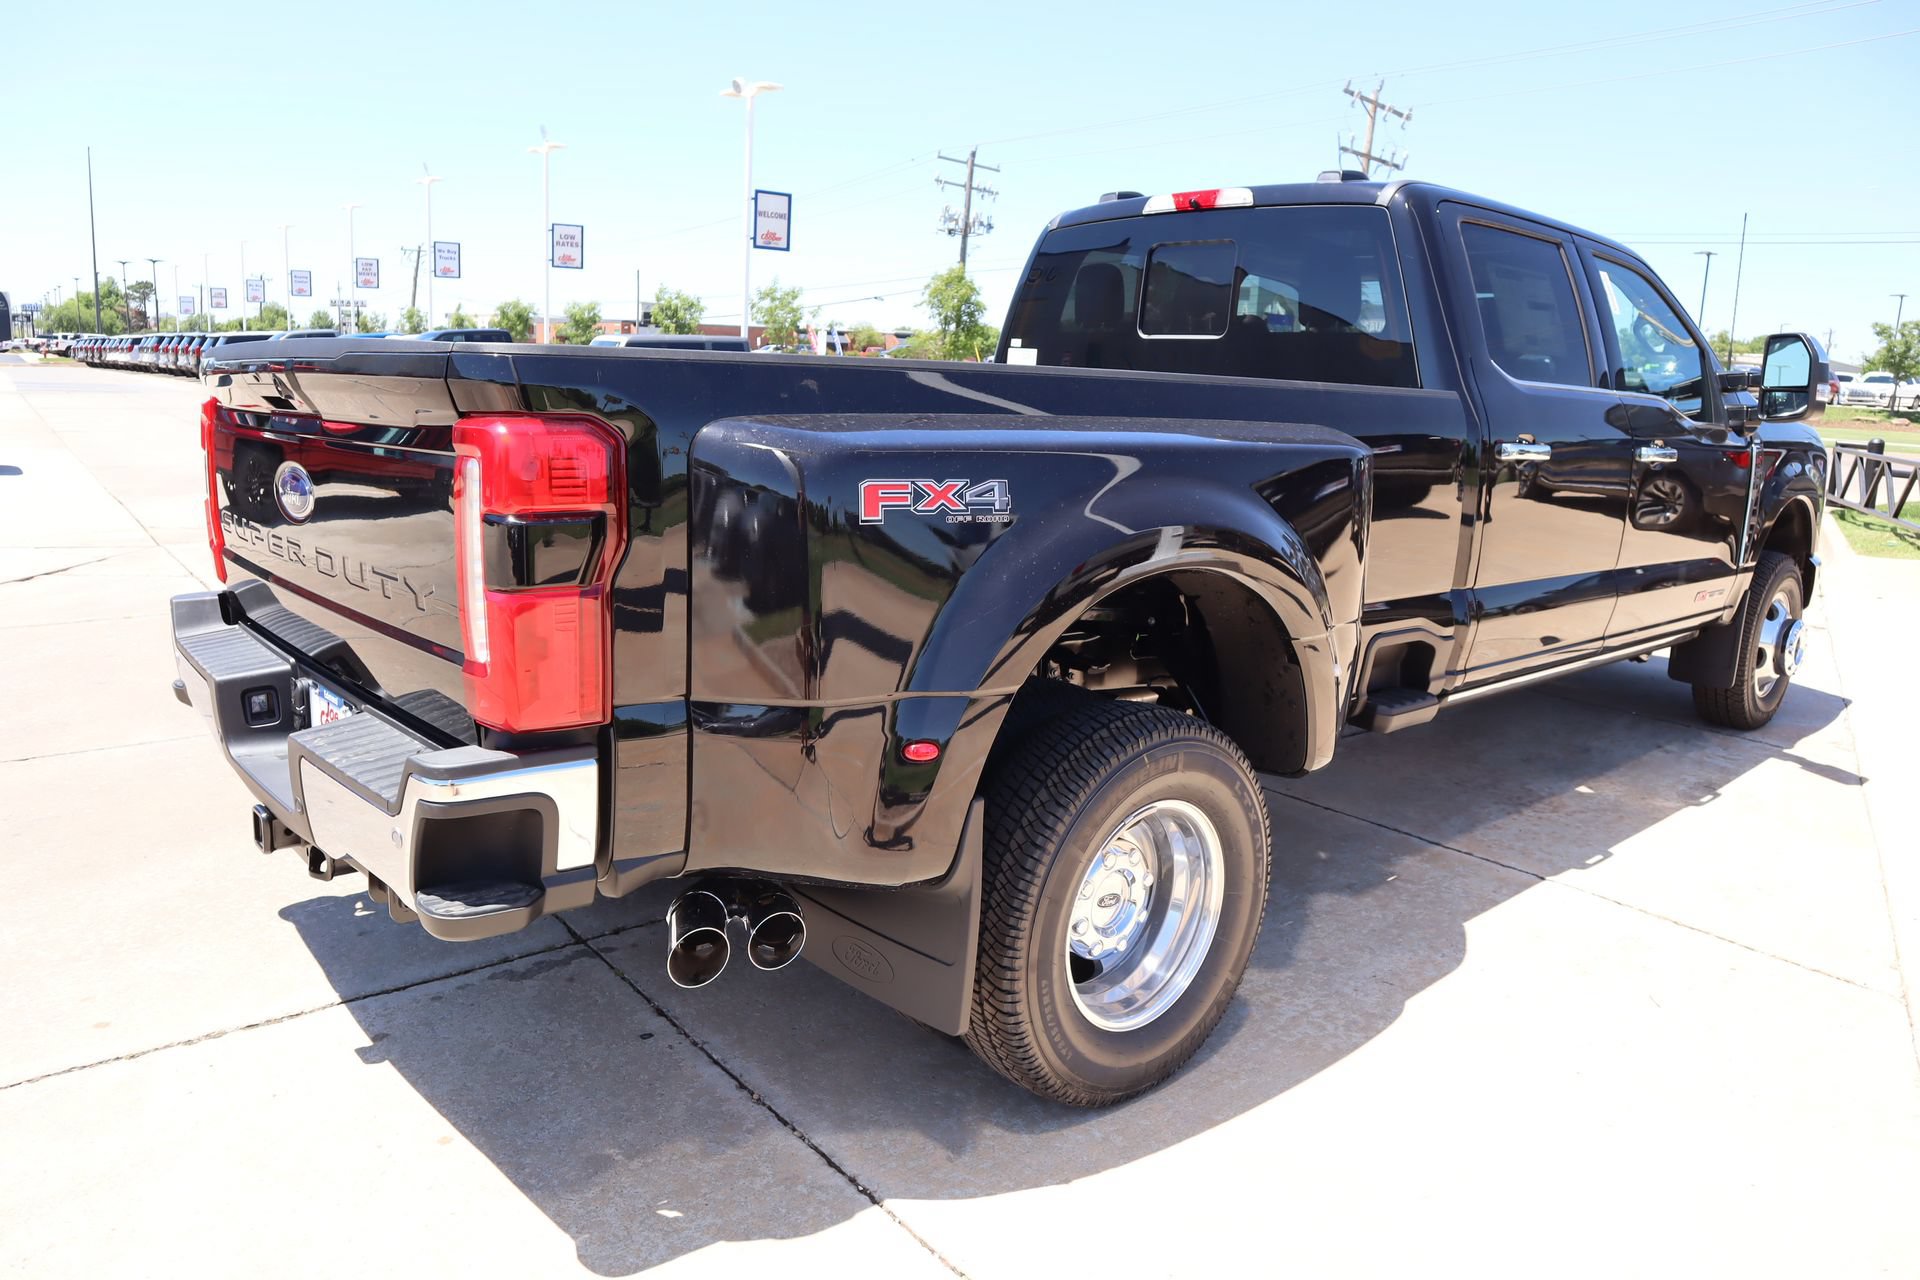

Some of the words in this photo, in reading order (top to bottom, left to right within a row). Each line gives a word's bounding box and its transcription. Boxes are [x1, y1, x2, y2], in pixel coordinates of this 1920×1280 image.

[758, 210, 787, 220] WELCOME
[556, 240, 579, 248] RATES
[859, 479, 1012, 525] FX4
[946, 515, 973, 523] OFF
[975, 515, 1010, 523] ROAD
[221, 509, 306, 567] SUPER
[314, 545, 435, 612] DUTY
[1233, 780, 1257, 824] LTX
[1099, 895, 1119, 907] Ford
[844, 942, 880, 977] Ford
